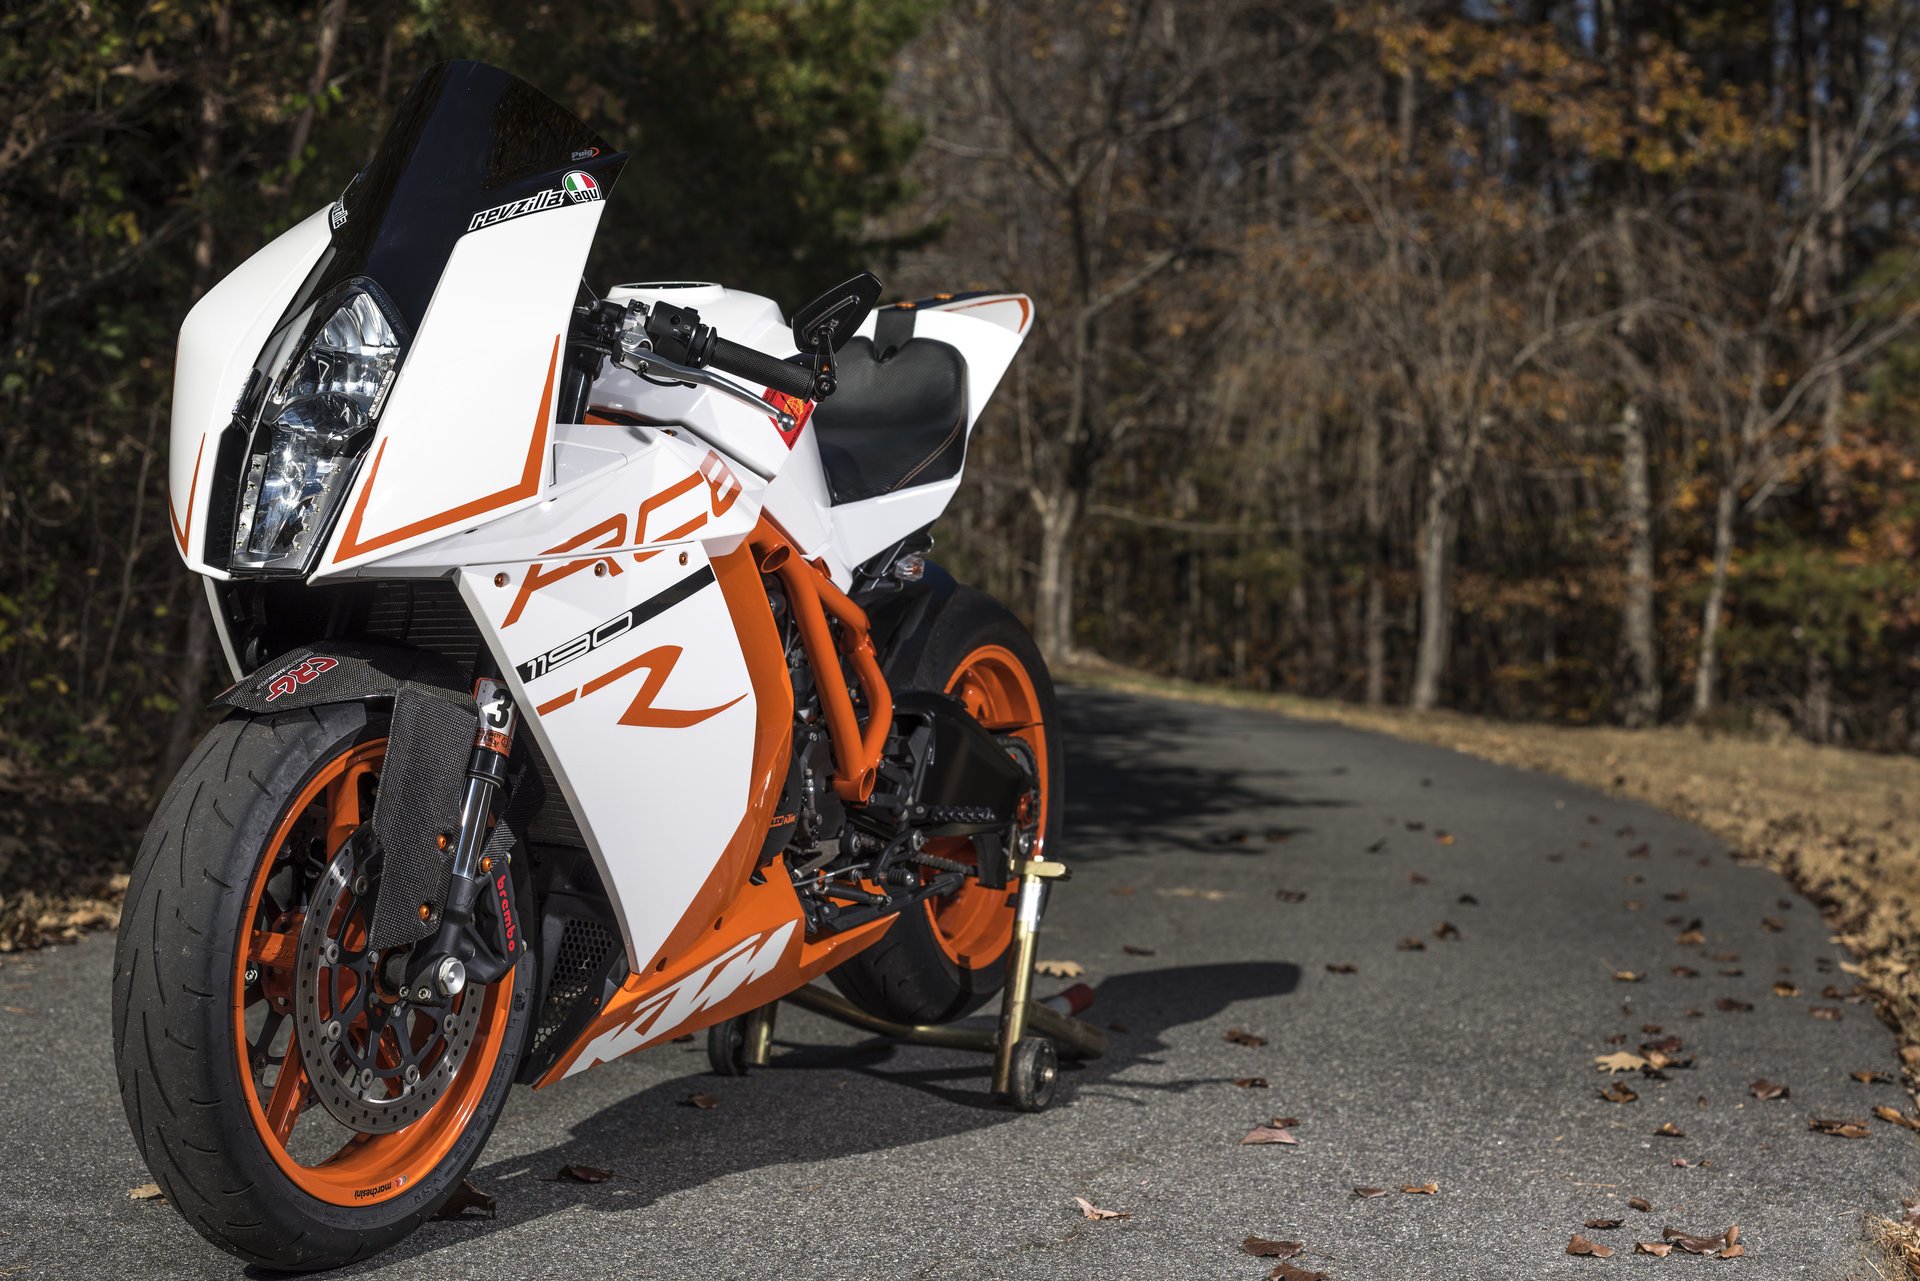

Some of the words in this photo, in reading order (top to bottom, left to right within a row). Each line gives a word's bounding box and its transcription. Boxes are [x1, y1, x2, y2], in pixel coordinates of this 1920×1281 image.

[571, 149, 593, 158] Puig
[468, 189, 565, 231] revzilla
[574, 188, 598, 203] agv
[527, 611, 633, 680] 1190
[266, 657, 338, 701] CRG
[487, 688, 513, 729] 3
[497, 875, 516, 952] brembo
[560, 919, 798, 1080] KTM
[354, 1182, 392, 1199] marchesini
